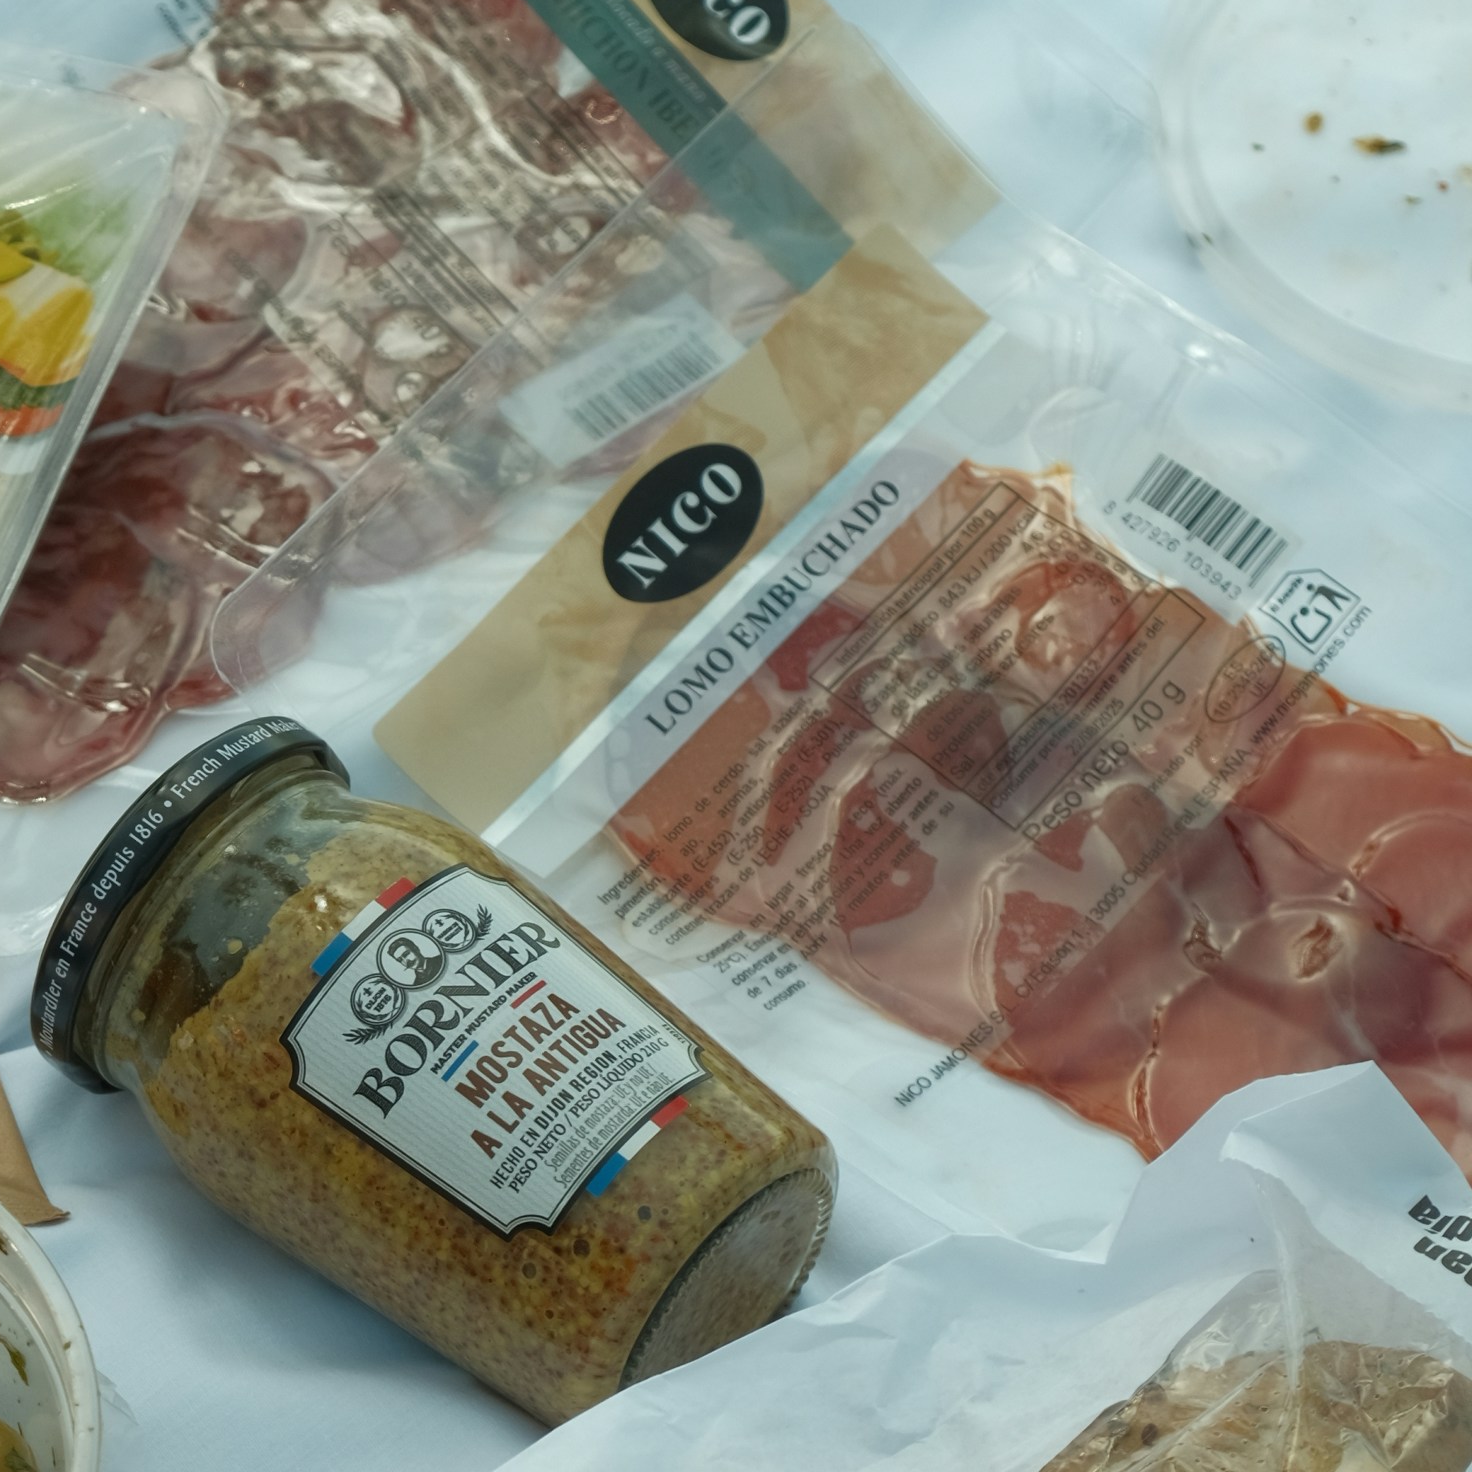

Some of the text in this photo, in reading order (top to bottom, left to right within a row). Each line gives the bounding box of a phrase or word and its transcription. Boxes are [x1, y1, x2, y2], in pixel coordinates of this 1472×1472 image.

[615, 461, 745, 589] NICO
[942, 538, 968, 562] por
[959, 514, 987, 540] 100
[1100, 497, 1118, 517] 8
[1118, 507, 1182, 556] 427926
[1179, 549, 1243, 602] 103943
[642, 642, 739, 737] LOMO
[726, 473, 905, 653] EMBUCHADO
[936, 579, 968, 610] 843
[982, 532, 1014, 562] 200
[1113, 638, 1150, 674] antes
[1222, 659, 1244, 682] ES
[170, 756, 223, 799] French
[217, 726, 270, 761] Mustard
[821, 726, 859, 764] Puede
[1020, 679, 1189, 847] Peso neto: 40 g
[129, 809, 164, 845] 1816
[661, 812, 695, 843] lomo
[692, 794, 712, 814] de
[710, 759, 750, 796] cerdo,
[793, 893, 809, 909] al
[838, 836, 865, 860] Una
[881, 774, 923, 817] abierto
[906, 787, 939, 821] antes
[918, 817, 939, 836] de
[936, 800, 956, 817] su
[924, 1018, 996, 1081] JAMONES
[1026, 937, 1077, 984] Edison
[1083, 881, 1129, 925] 13005
[1118, 836, 1167, 889] Ciudad
[1247, 600, 1374, 748] www.nicojamones.com
[93, 847, 135, 900] depuis
[677, 834, 705, 859] ajo,
[703, 880, 740, 917] trazas
[736, 864, 756, 883] de
[750, 823, 794, 867] LECHE
[797, 781, 834, 818] SOJA
[748, 840, 834, 930] en lugar fresco
[55, 959, 71, 978] en
[60, 902, 98, 957] France
[352, 921, 560, 1119] BORNIER
[364, 985, 386, 1010] DIJON
[429, 970, 538, 1075] MASTER MUSTARD MAKER
[453, 990, 580, 1109] MOSTAZA
[466, 1004, 627, 1160] A LA ANTIGUA
[487, 1144, 527, 1189] HECHO
[518, 1126, 541, 1149] EN
[532, 1087, 575, 1130] DIJON
[567, 1046, 623, 1093] REGION,
[614, 1023, 660, 1054] FRANCIA
[507, 1035, 670, 1193] PESO NETO PESO LÍQUIDO 210 G
[542, 1132, 581, 1172] Semillas
[571, 1122, 590, 1140] de
[611, 1084, 630, 1099] UE
[551, 1144, 596, 1189] Sementes
[584, 1132, 603, 1150] de
